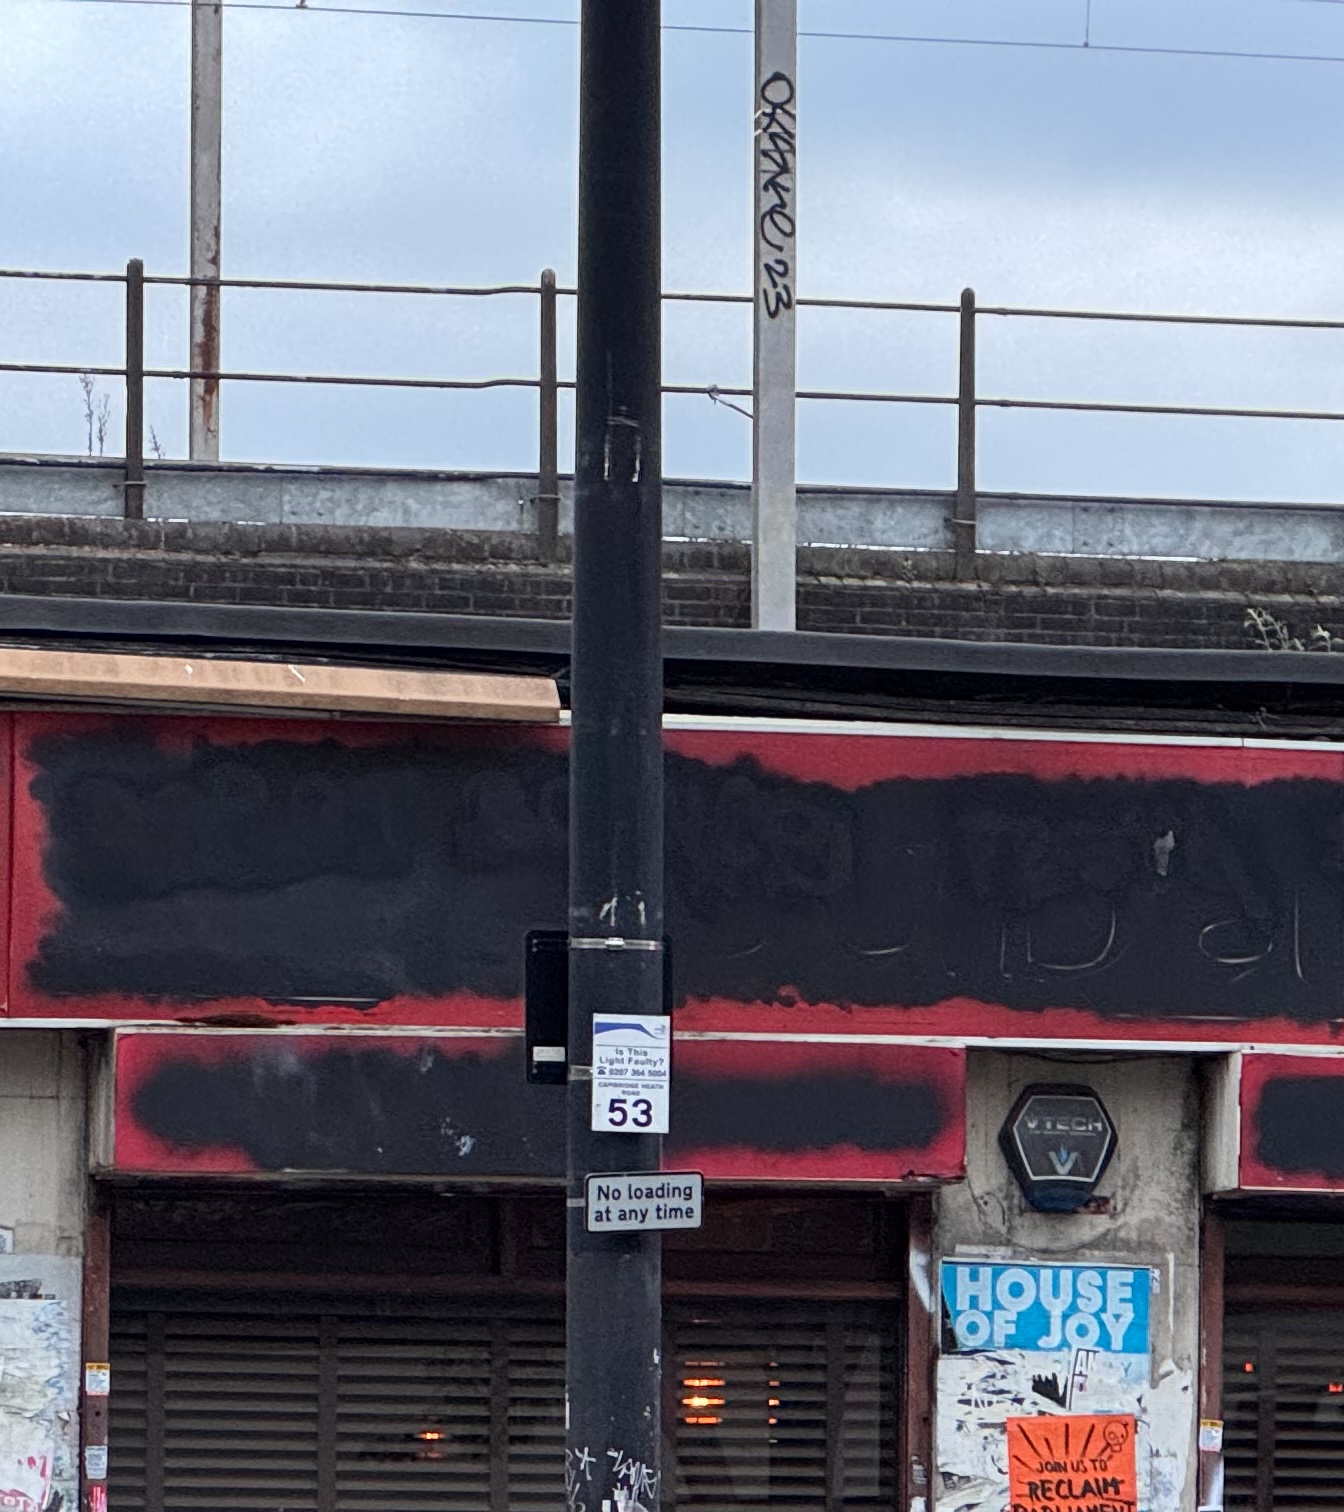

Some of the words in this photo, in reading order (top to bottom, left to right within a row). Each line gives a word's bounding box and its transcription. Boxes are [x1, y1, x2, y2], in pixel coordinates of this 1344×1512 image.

[608, 1098, 653, 1128] 53
[597, 1185, 621, 1201] No
[628, 1182, 693, 1201] loading
[594, 1206, 611, 1222] at
[618, 1208, 649, 1224] any
[656, 1204, 695, 1220] time
[956, 1266, 1135, 1315] HOUSE
[956, 1309, 1018, 1347] OF
[1036, 1311, 1135, 1350] JOY
[1036, 1461, 1067, 1474] JOIN
[1070, 1460, 1087, 1474] US
[1089, 1458, 1108, 1473] TO
[1026, 1476, 1125, 1503] RECLAIM
